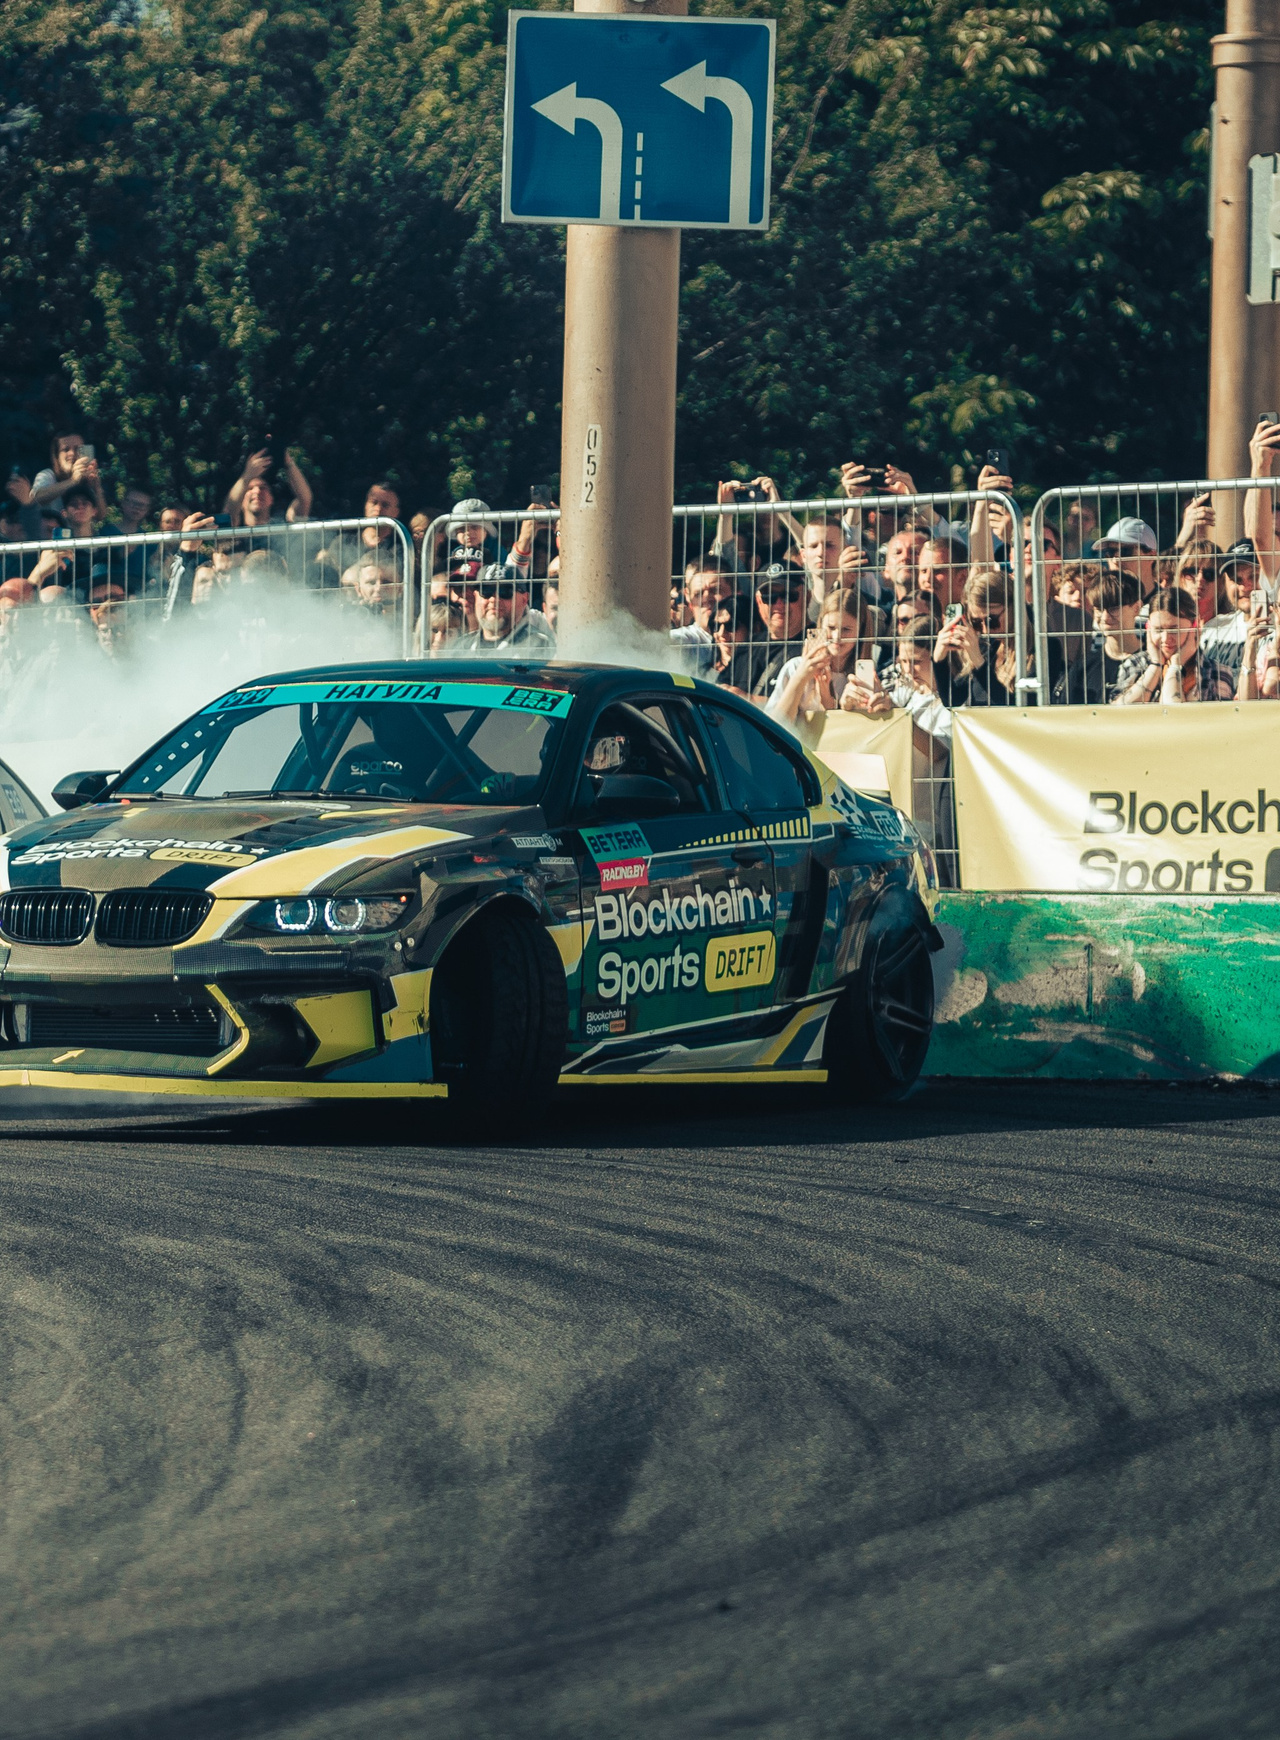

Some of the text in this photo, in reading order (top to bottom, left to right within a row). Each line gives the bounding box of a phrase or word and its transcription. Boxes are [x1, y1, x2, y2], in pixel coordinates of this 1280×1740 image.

[585, 428, 598, 503] 052
[223, 688, 272, 707] 999
[324, 684, 442, 700] НАГУЛА
[1084, 788, 1280, 834] Blockch
[24, 838, 244, 854] Blockchain
[11, 847, 245, 865] Sports DRIFT
[1076, 848, 1254, 892] Sports
[595, 879, 756, 941] Blockchain
[598, 944, 766, 1005] Sports DRIFT
[586, 1009, 623, 1022] Blockchain
[586, 1022, 610, 1035] Sports
